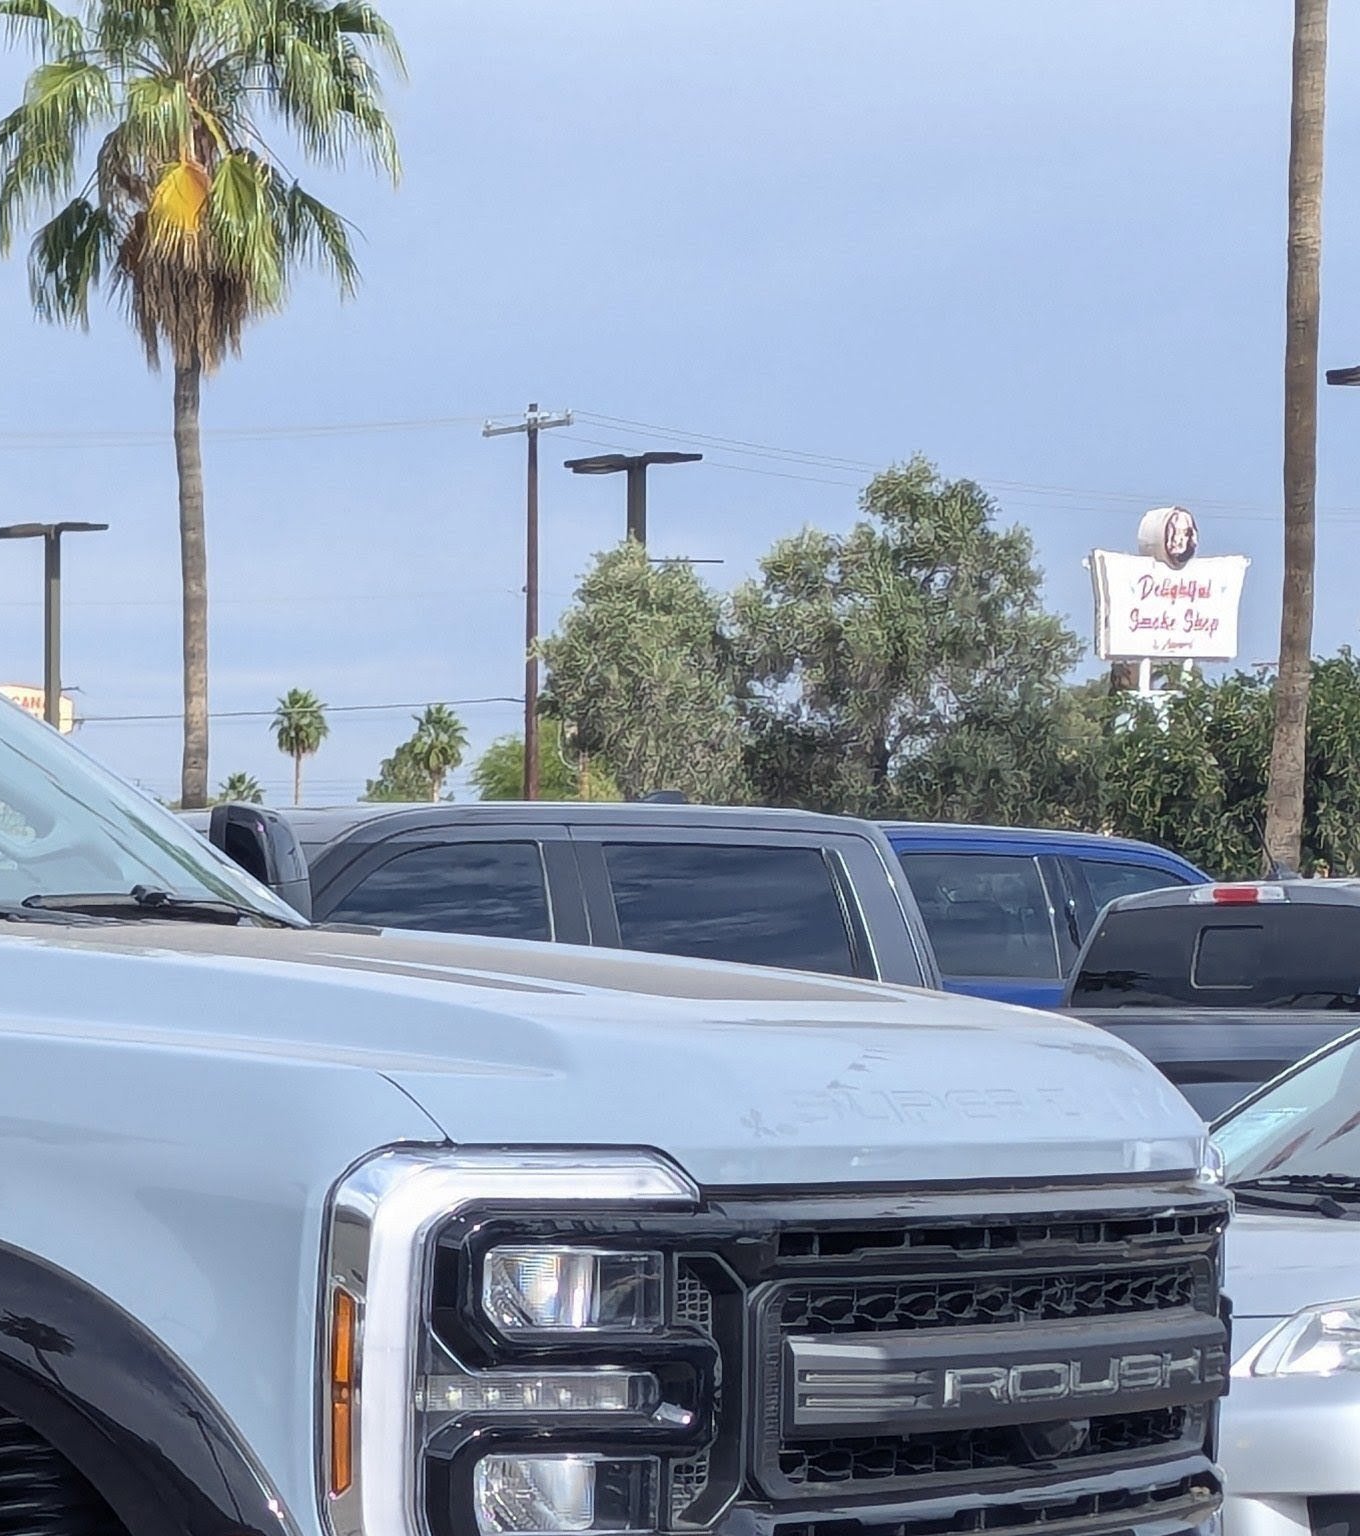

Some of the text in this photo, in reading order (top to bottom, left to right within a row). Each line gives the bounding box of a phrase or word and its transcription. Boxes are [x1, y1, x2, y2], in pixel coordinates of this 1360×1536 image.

[1129, 608, 1220, 638] Smoke Shop
[942, 1346, 1203, 1410] ROUSH
